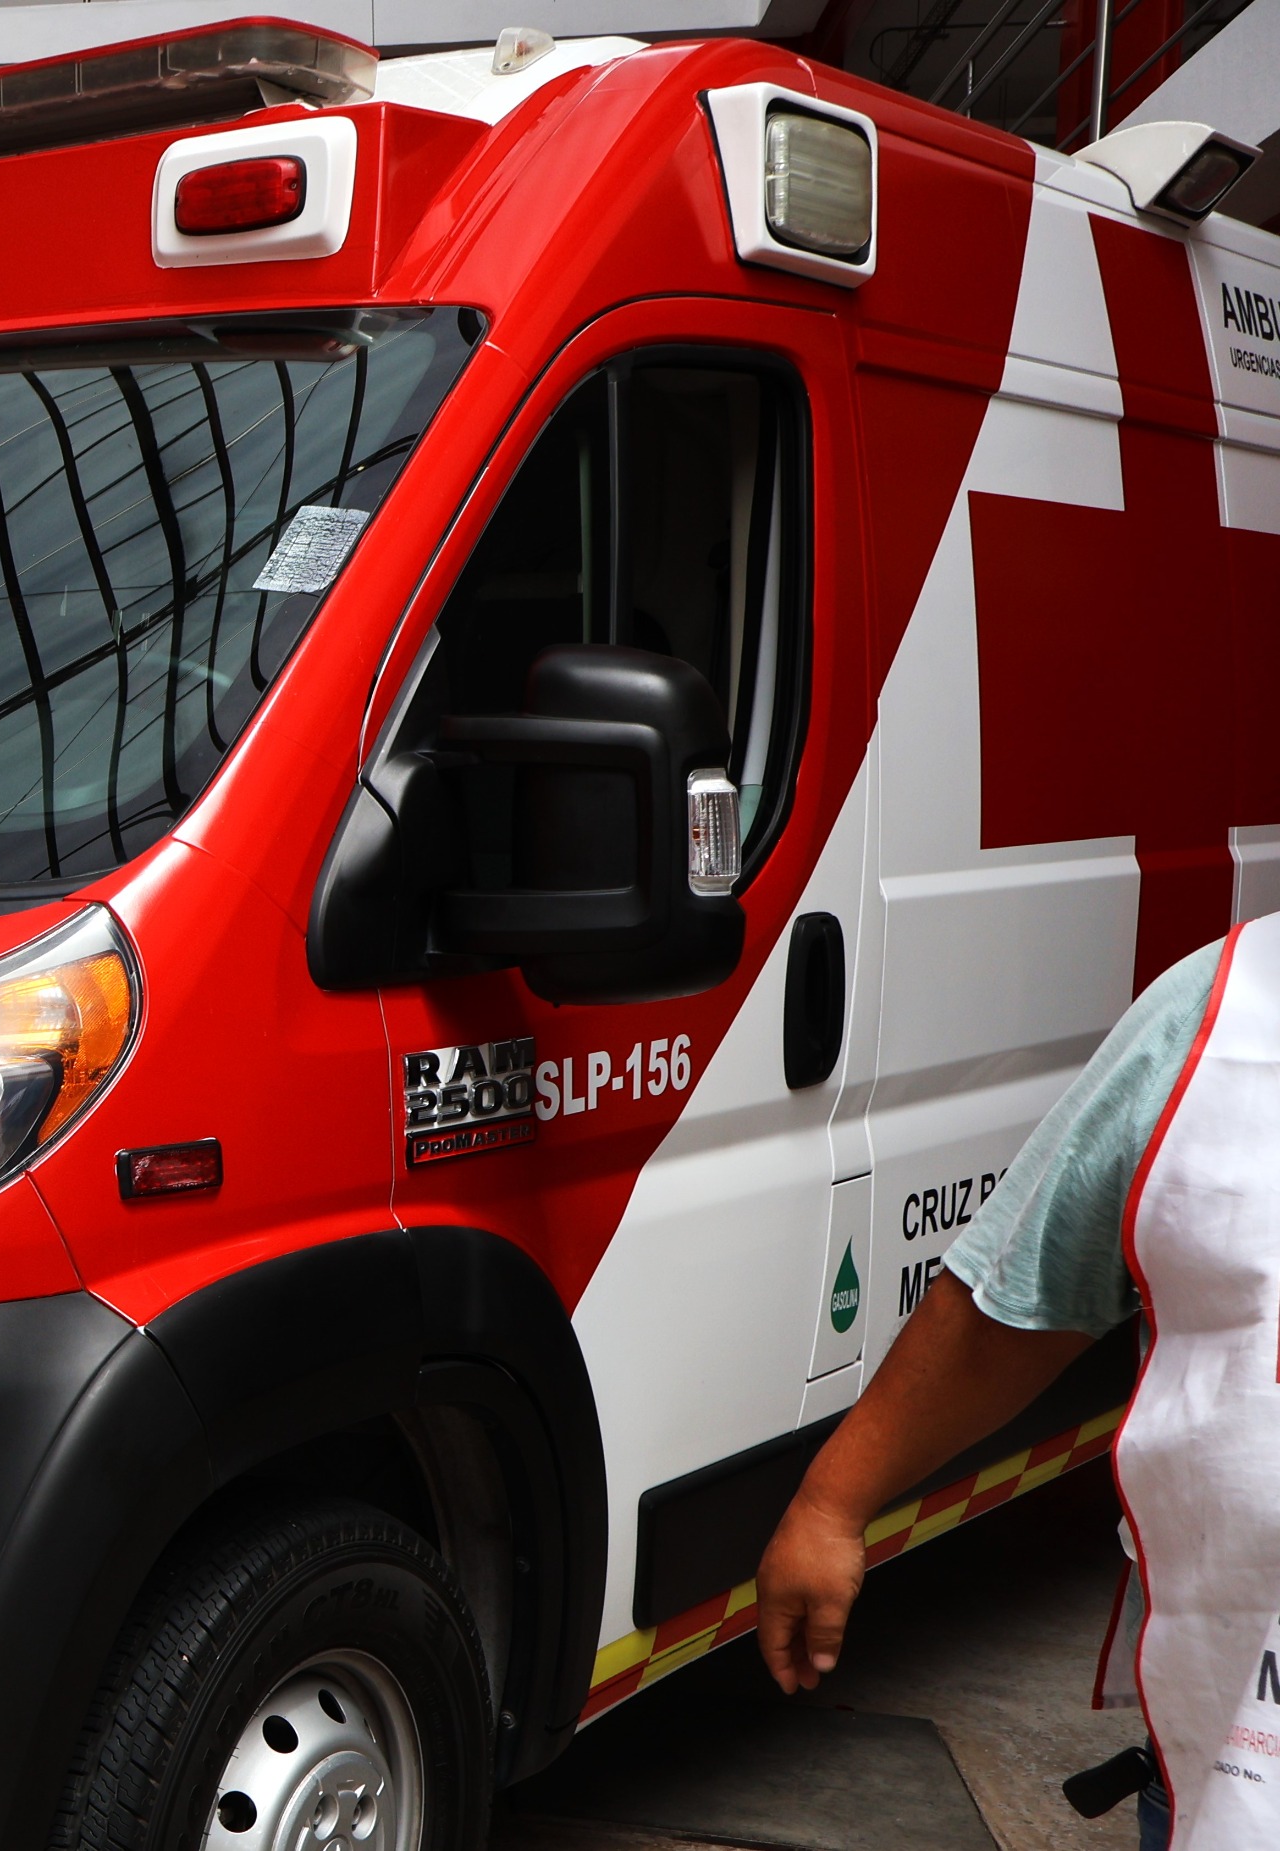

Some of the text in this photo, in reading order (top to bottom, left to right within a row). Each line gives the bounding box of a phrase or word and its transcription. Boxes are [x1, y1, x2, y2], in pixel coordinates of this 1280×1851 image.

[404, 1037, 535, 1088] RAM
[535, 1033, 691, 1122] SLP-156
[405, 1073, 536, 1126] 2500
[902, 1178, 973, 1241] CRUZ
[832, 1288, 858, 1312] GASOLINA
